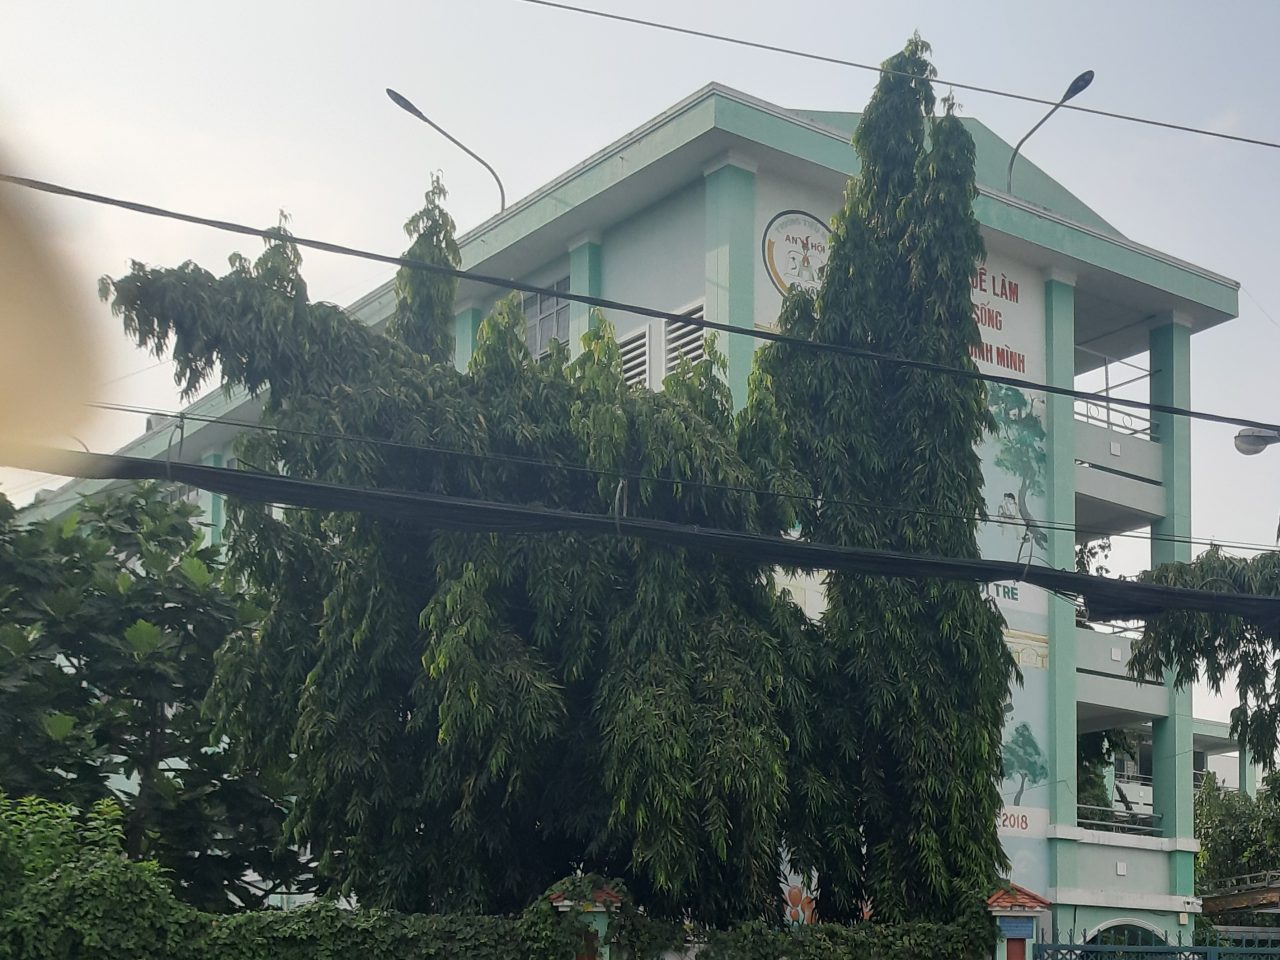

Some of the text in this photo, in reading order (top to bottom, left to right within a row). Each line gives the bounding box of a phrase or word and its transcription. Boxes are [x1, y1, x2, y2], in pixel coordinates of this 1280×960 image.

[785, 234, 798, 245] AN
[992, 273, 1019, 303] LÀM
[972, 301, 1002, 330] SỐNG
[996, 344, 1025, 373] MÌNH
[1002, 812, 1028, 830] 2018
